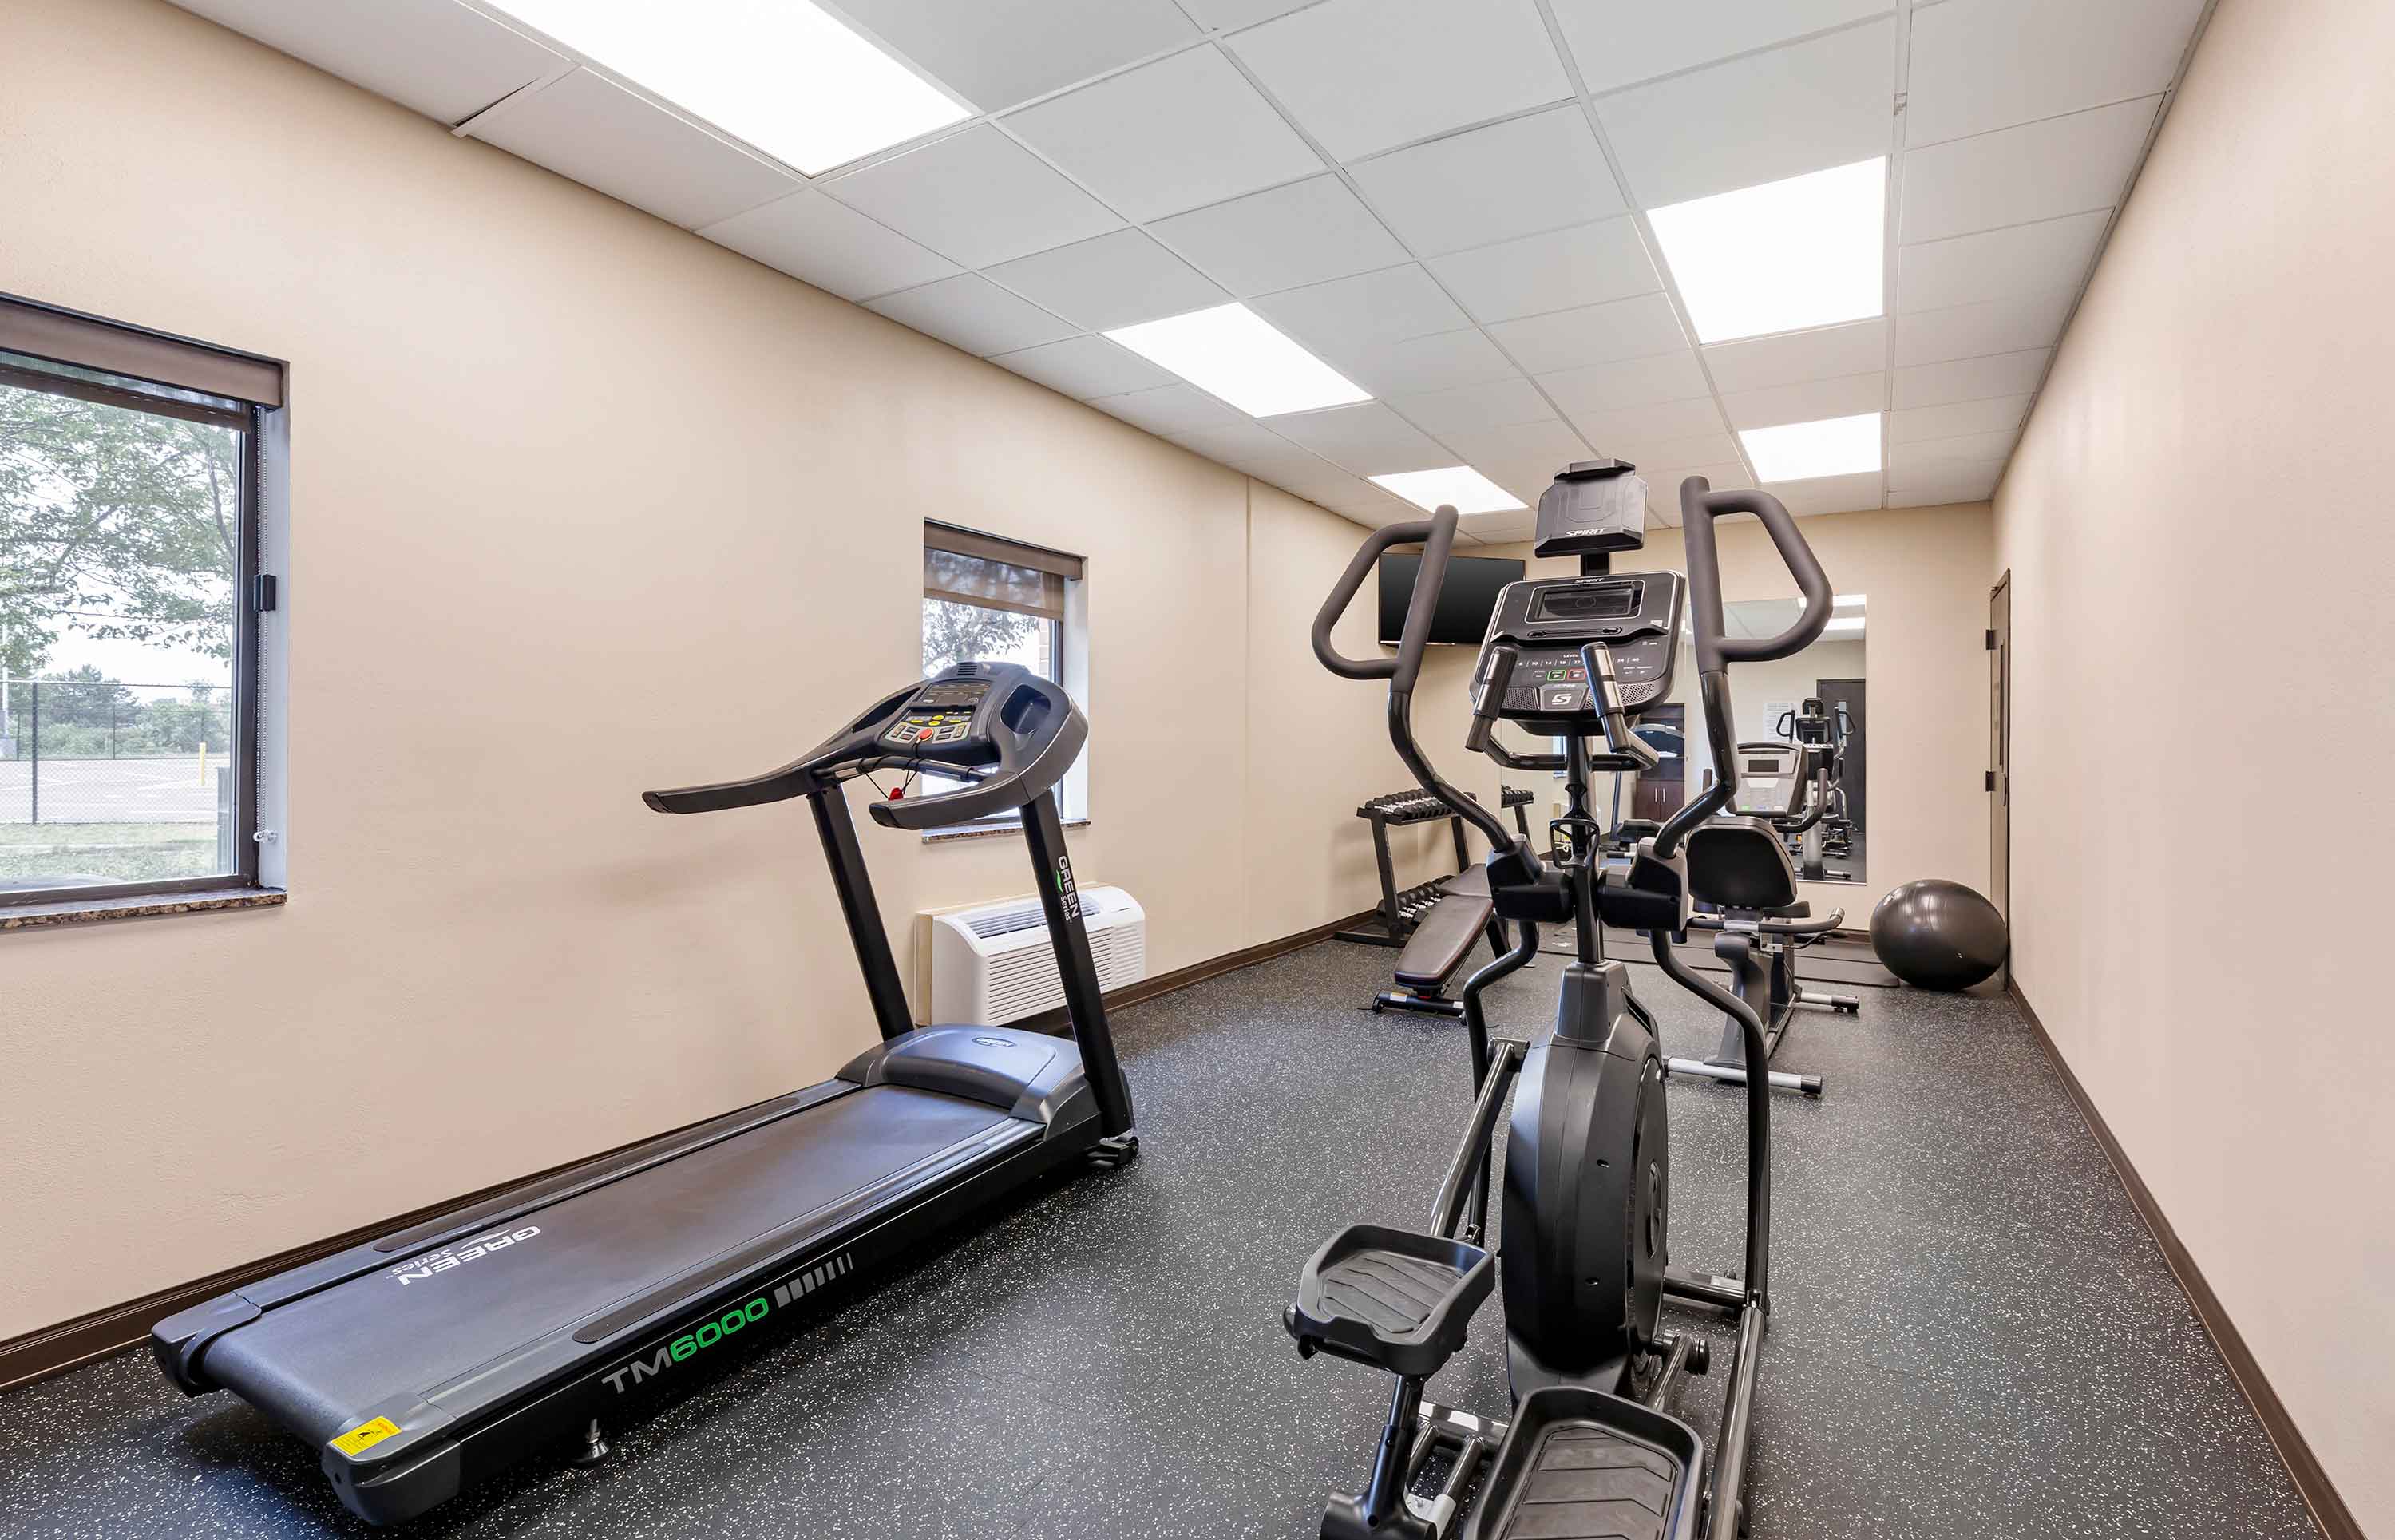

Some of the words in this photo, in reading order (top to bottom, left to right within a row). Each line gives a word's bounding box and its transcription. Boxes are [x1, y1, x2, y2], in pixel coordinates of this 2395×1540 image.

[1565, 528, 1606, 537] SPIRIT
[1059, 855, 1080, 918] GREEN
[1060, 895, 1071, 921] Series
[392, 1249, 453, 1275] Series
[398, 1225, 541, 1285] GREEN
[600, 1297, 770, 1394] TM6000
